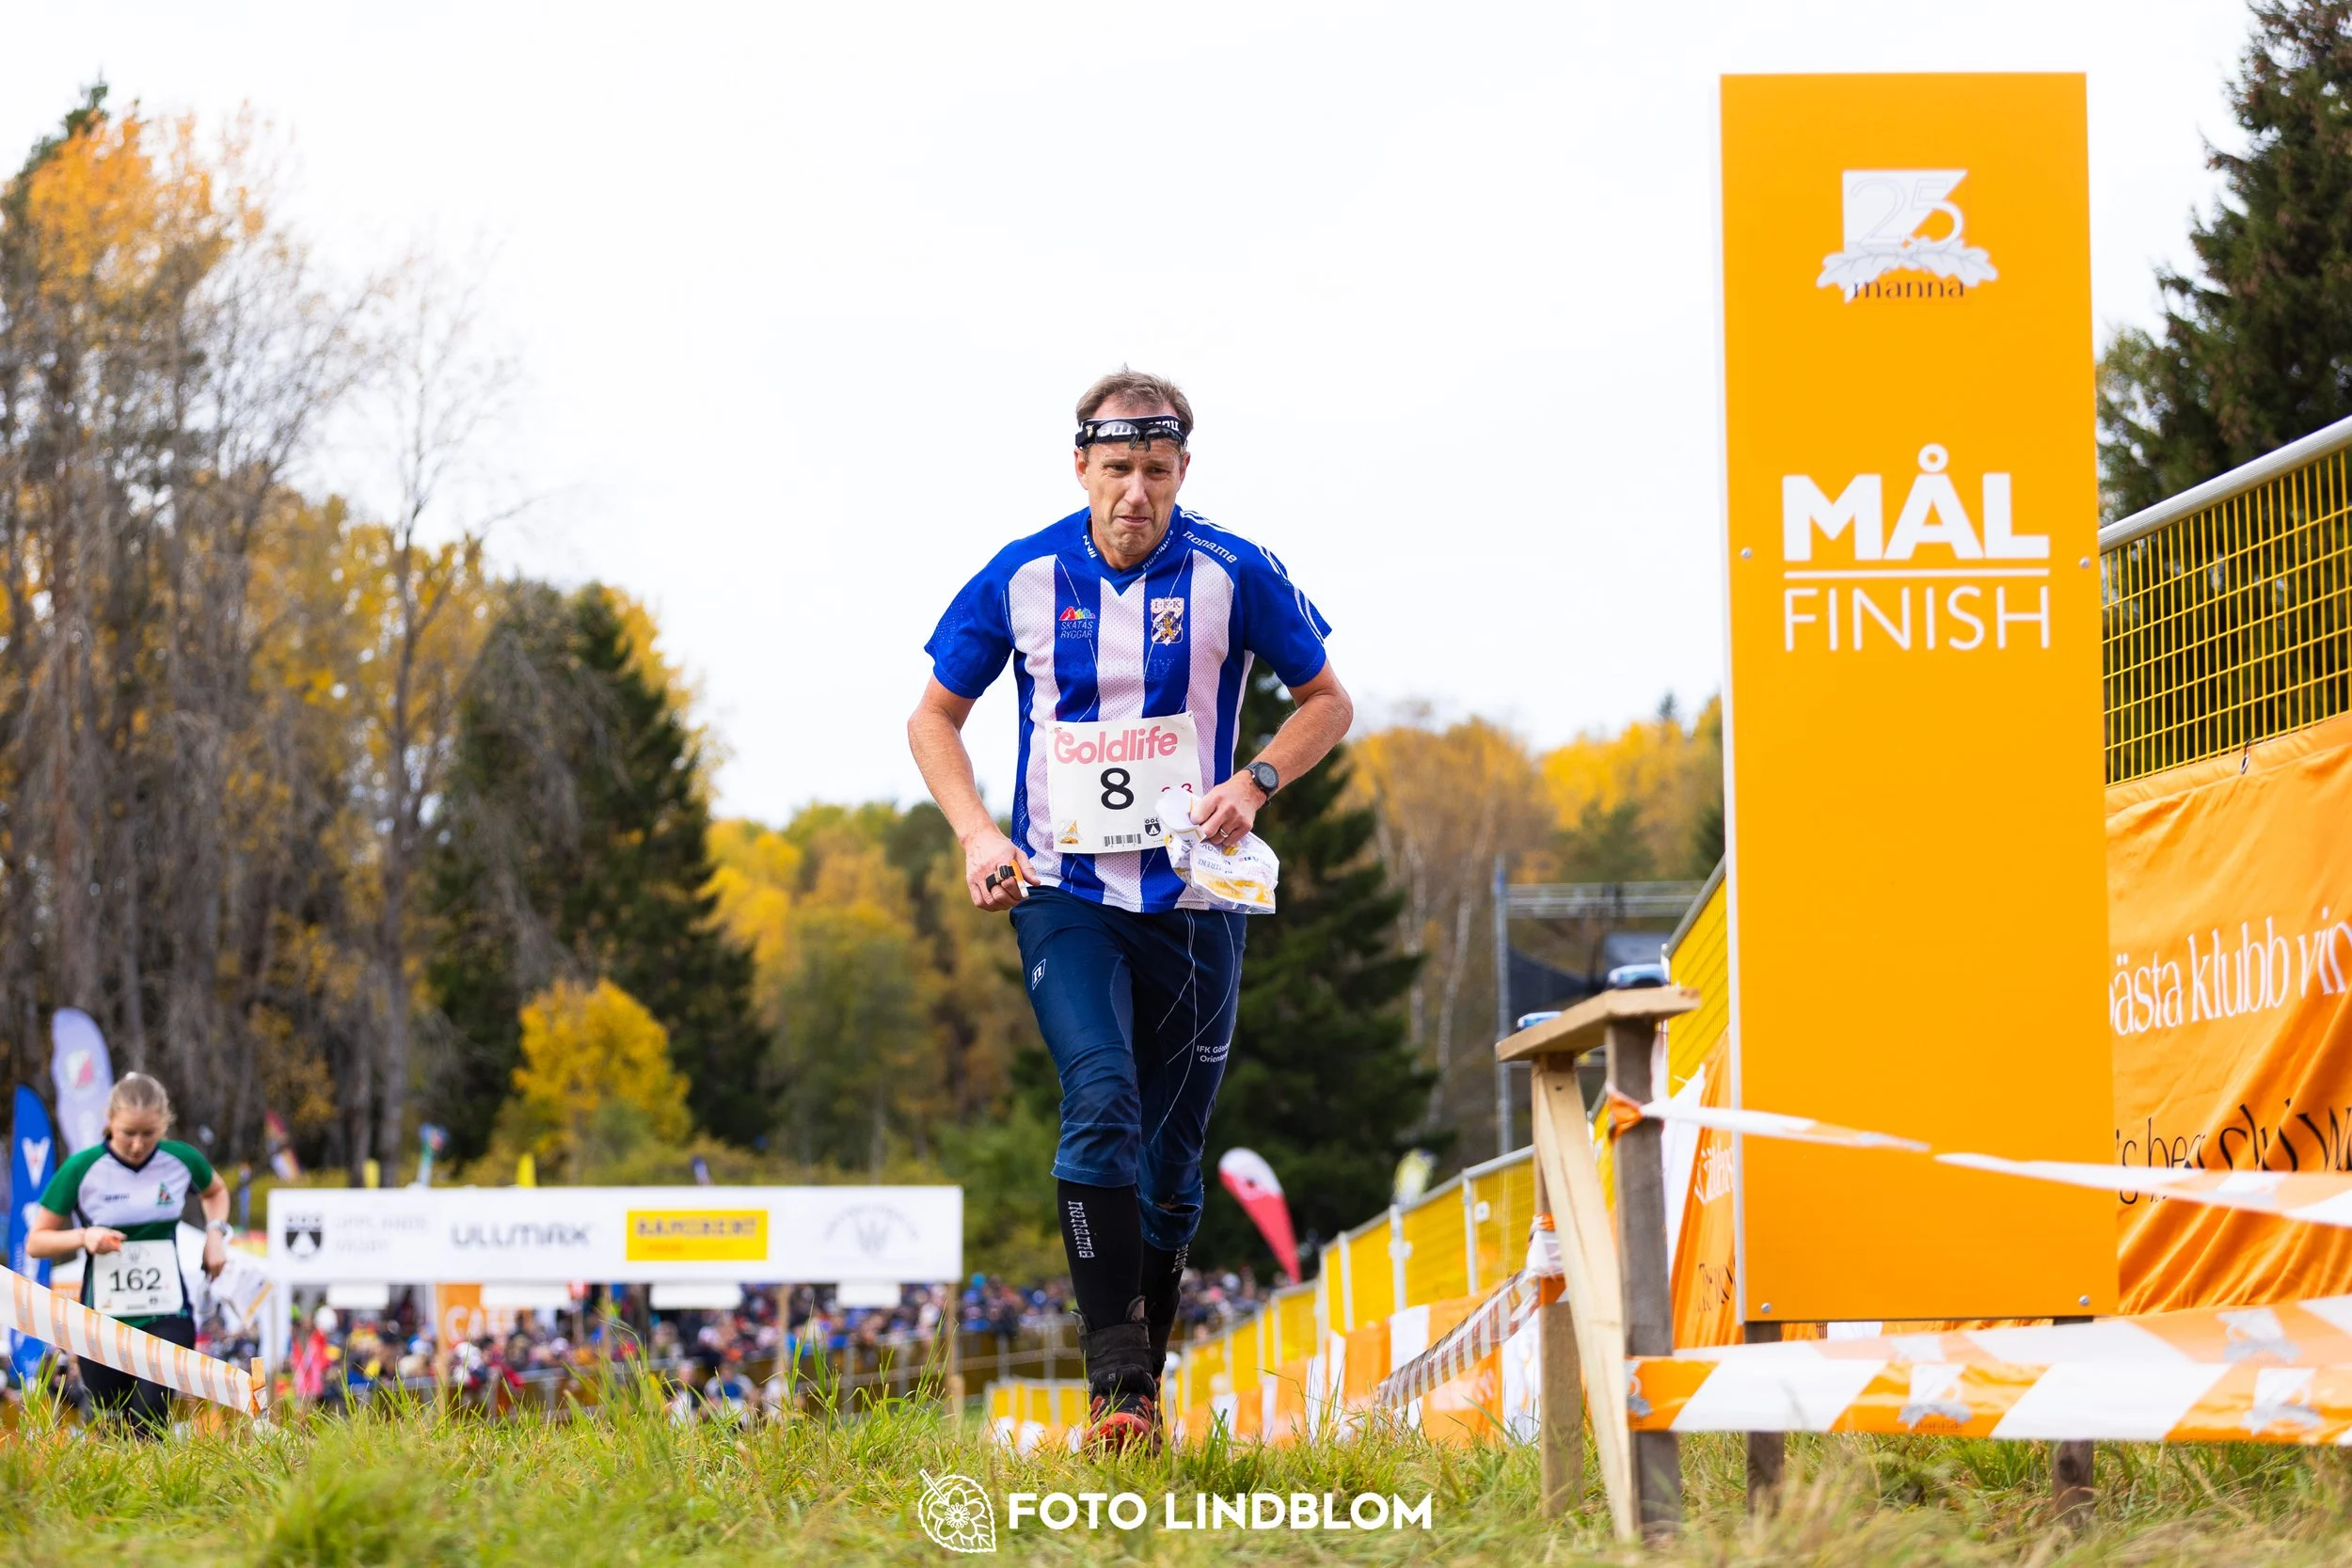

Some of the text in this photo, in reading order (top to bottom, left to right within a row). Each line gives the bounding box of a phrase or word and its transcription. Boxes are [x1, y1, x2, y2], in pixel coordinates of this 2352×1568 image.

[1853, 280, 1964, 298] manna
[1782, 443, 2050, 562] MÅL
[1182, 530, 1239, 563] noname
[1785, 585, 2050, 651] FINISH
[1054, 725, 1178, 764] Goldlife
[1100, 768, 1135, 810] 8
[2108, 952, 2184, 1037] ästa
[2188, 915, 2290, 1023] klubb
[1196, 1044, 1211, 1053] IFK
[1068, 1200, 1095, 1259] noname
[109, 1267, 162, 1293] 162
